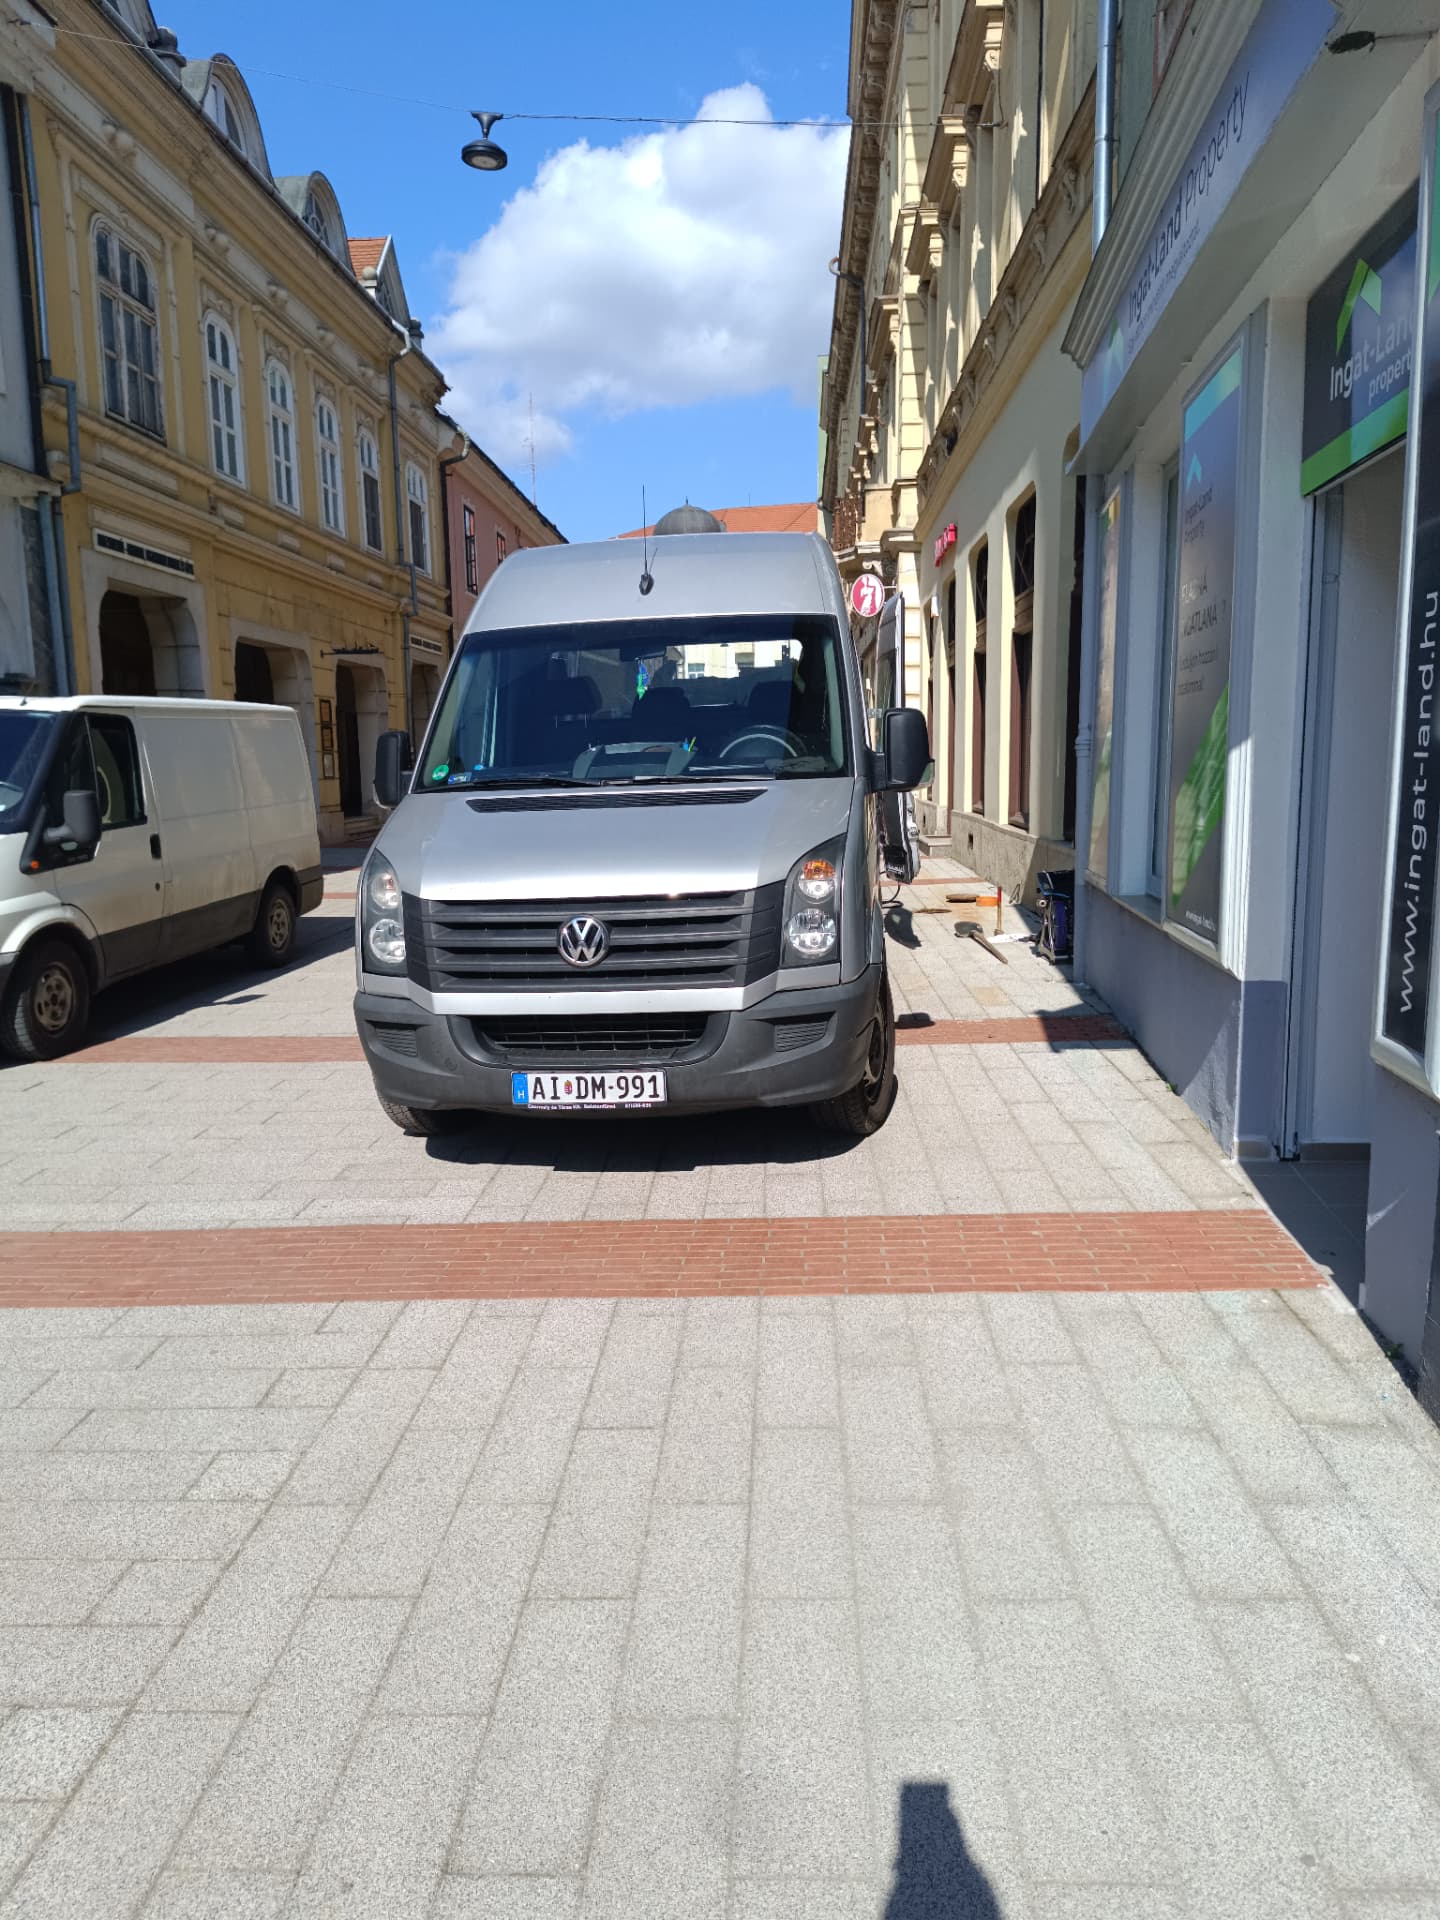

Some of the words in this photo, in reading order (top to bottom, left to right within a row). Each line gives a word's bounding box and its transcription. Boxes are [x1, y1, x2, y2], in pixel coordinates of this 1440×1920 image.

[1129, 186, 1181, 327] Ingat-Land
[1185, 72, 1250, 220] Property
[1368, 349, 1412, 405] propert
[1400, 591, 1439, 1013] www.ingat-land.hu
[532, 1076, 561, 1101] AI
[575, 1074, 660, 1100] DM-991
